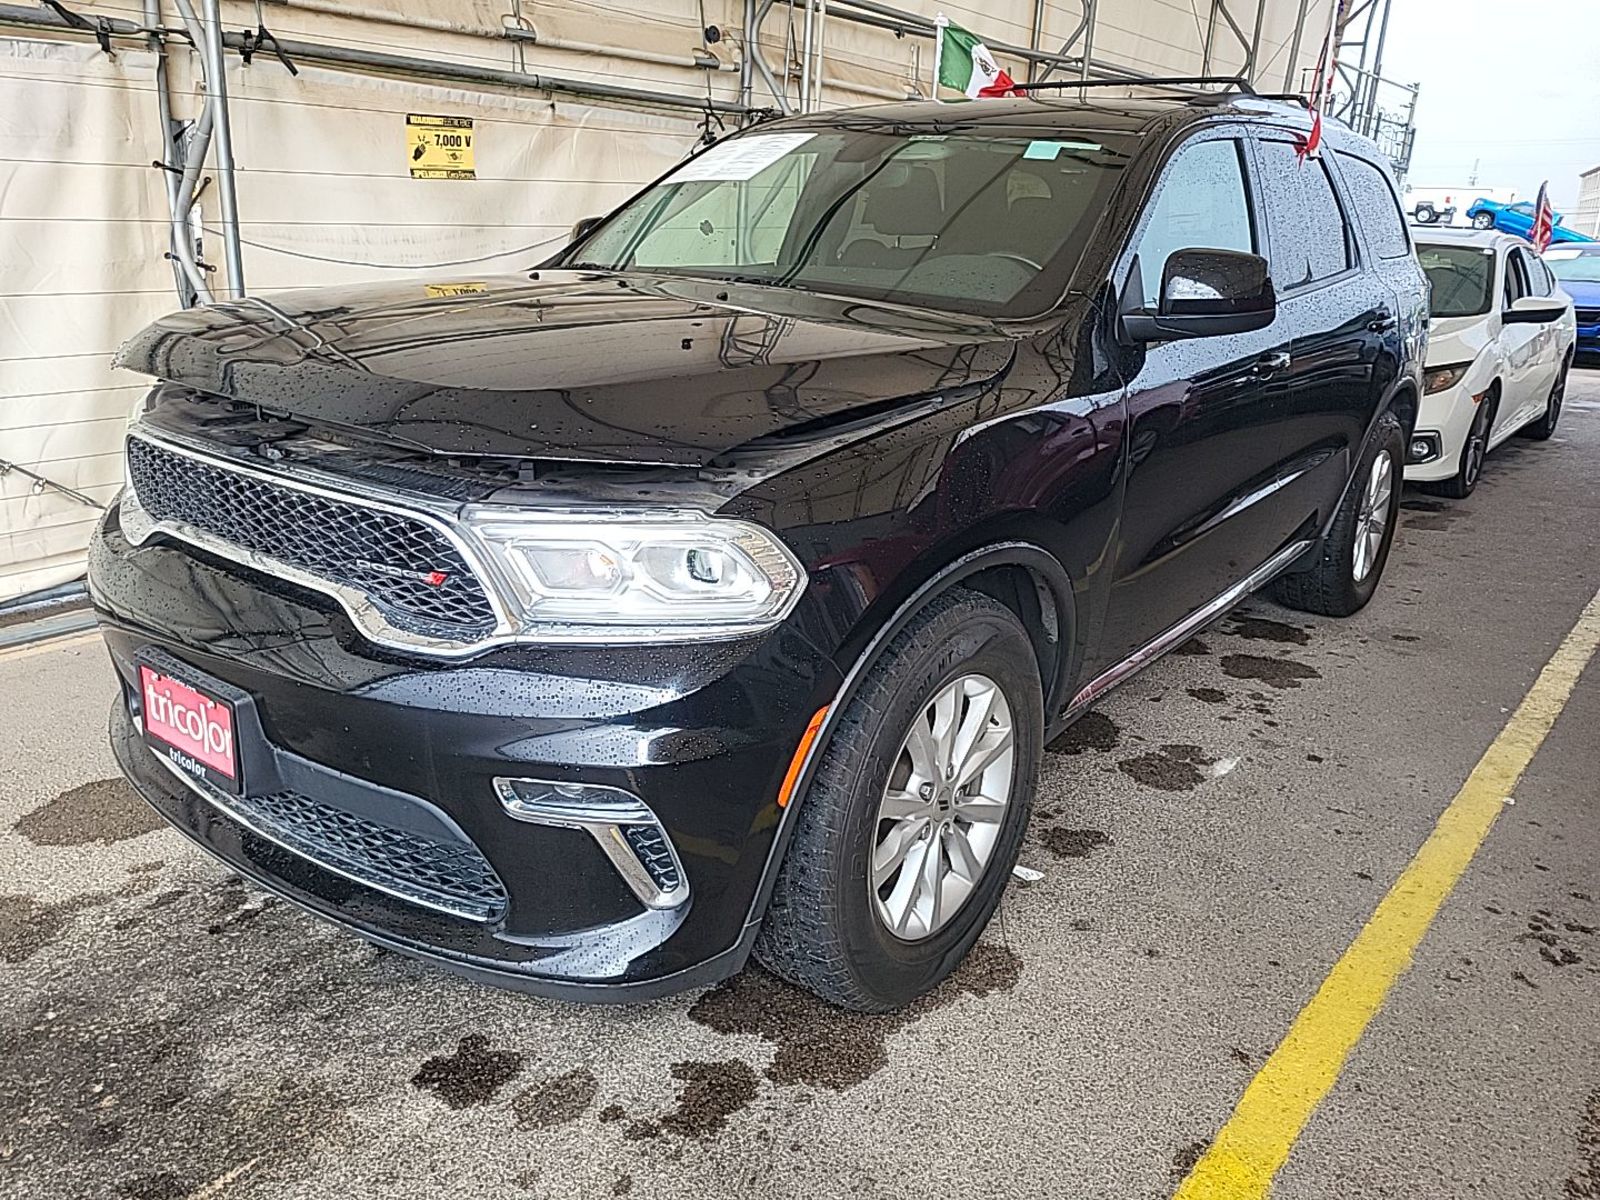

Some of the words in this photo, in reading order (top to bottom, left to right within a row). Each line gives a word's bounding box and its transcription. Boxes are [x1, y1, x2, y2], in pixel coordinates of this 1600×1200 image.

[434, 133, 462, 149] 7,000
[464, 135, 472, 148] V
[147, 684, 232, 760] tricolor
[169, 747, 206, 778] tricolor
